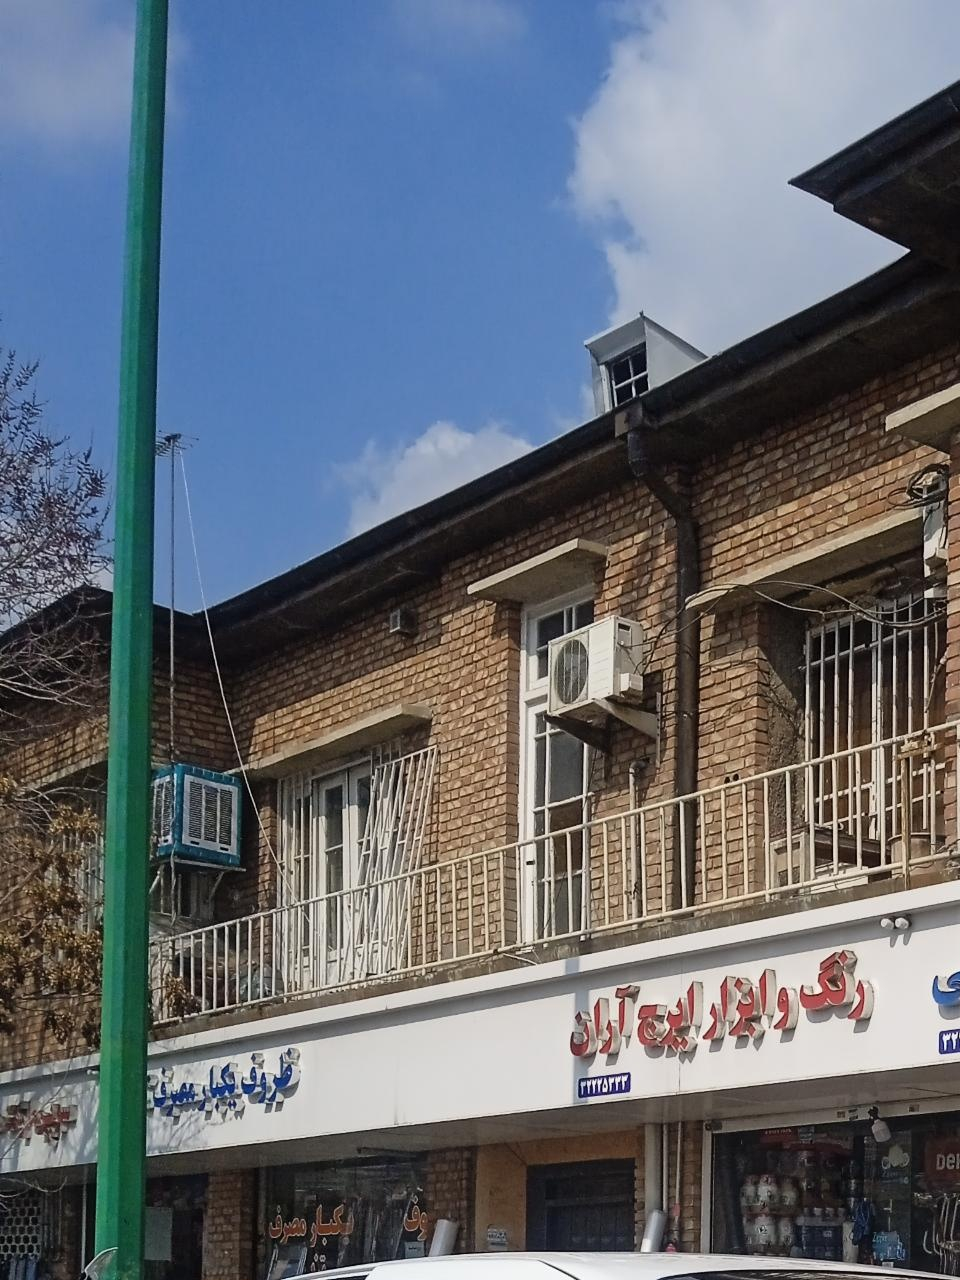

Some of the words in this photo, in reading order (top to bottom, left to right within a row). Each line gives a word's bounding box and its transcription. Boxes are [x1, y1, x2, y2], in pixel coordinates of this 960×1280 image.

[799, 949, 875, 1021] رنگ
[241, 1047, 300, 1104] ظروف
[268, 1205, 307, 1245] مصرف
